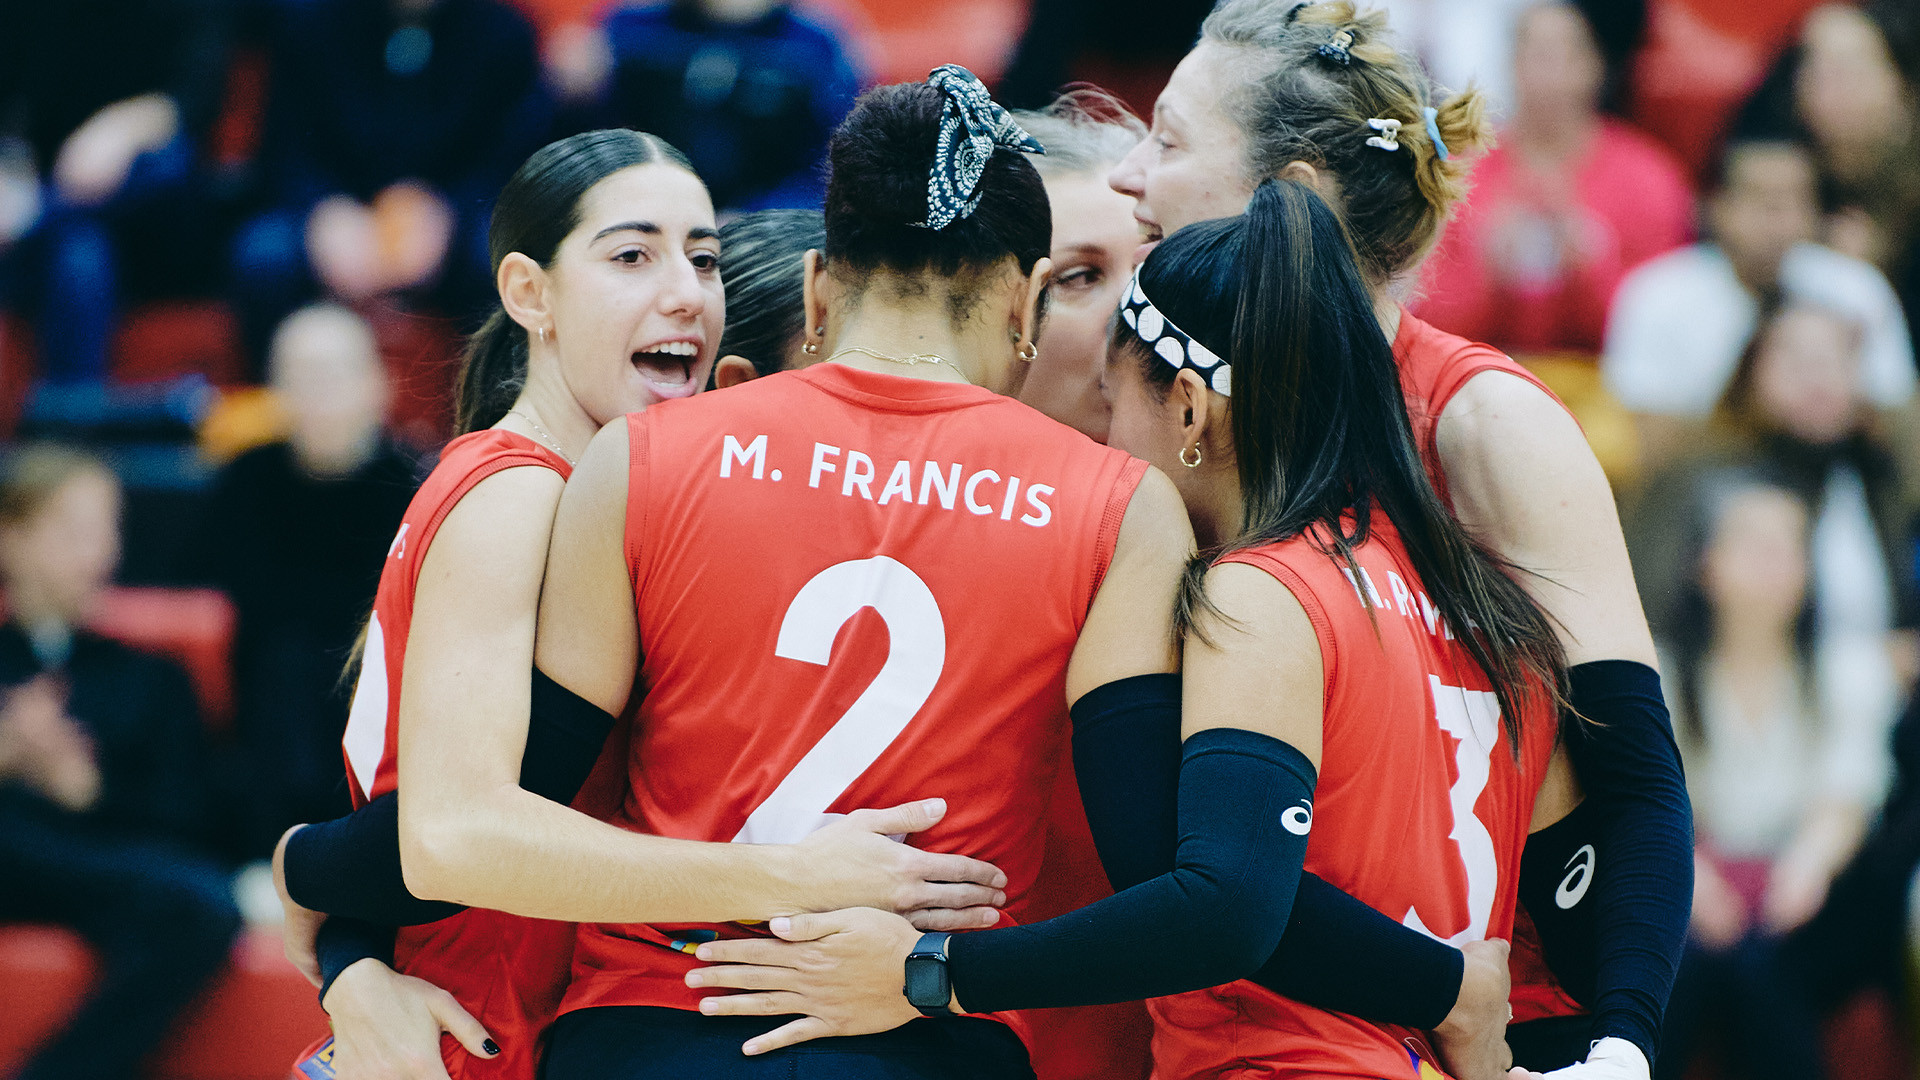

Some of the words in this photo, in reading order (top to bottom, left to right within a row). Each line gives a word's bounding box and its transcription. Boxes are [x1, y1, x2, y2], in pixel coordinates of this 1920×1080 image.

[720, 434, 783, 482] M.
[809, 442, 1056, 527] FRANCIS
[731, 555, 946, 845] 2
[1402, 673, 1501, 949] 3
